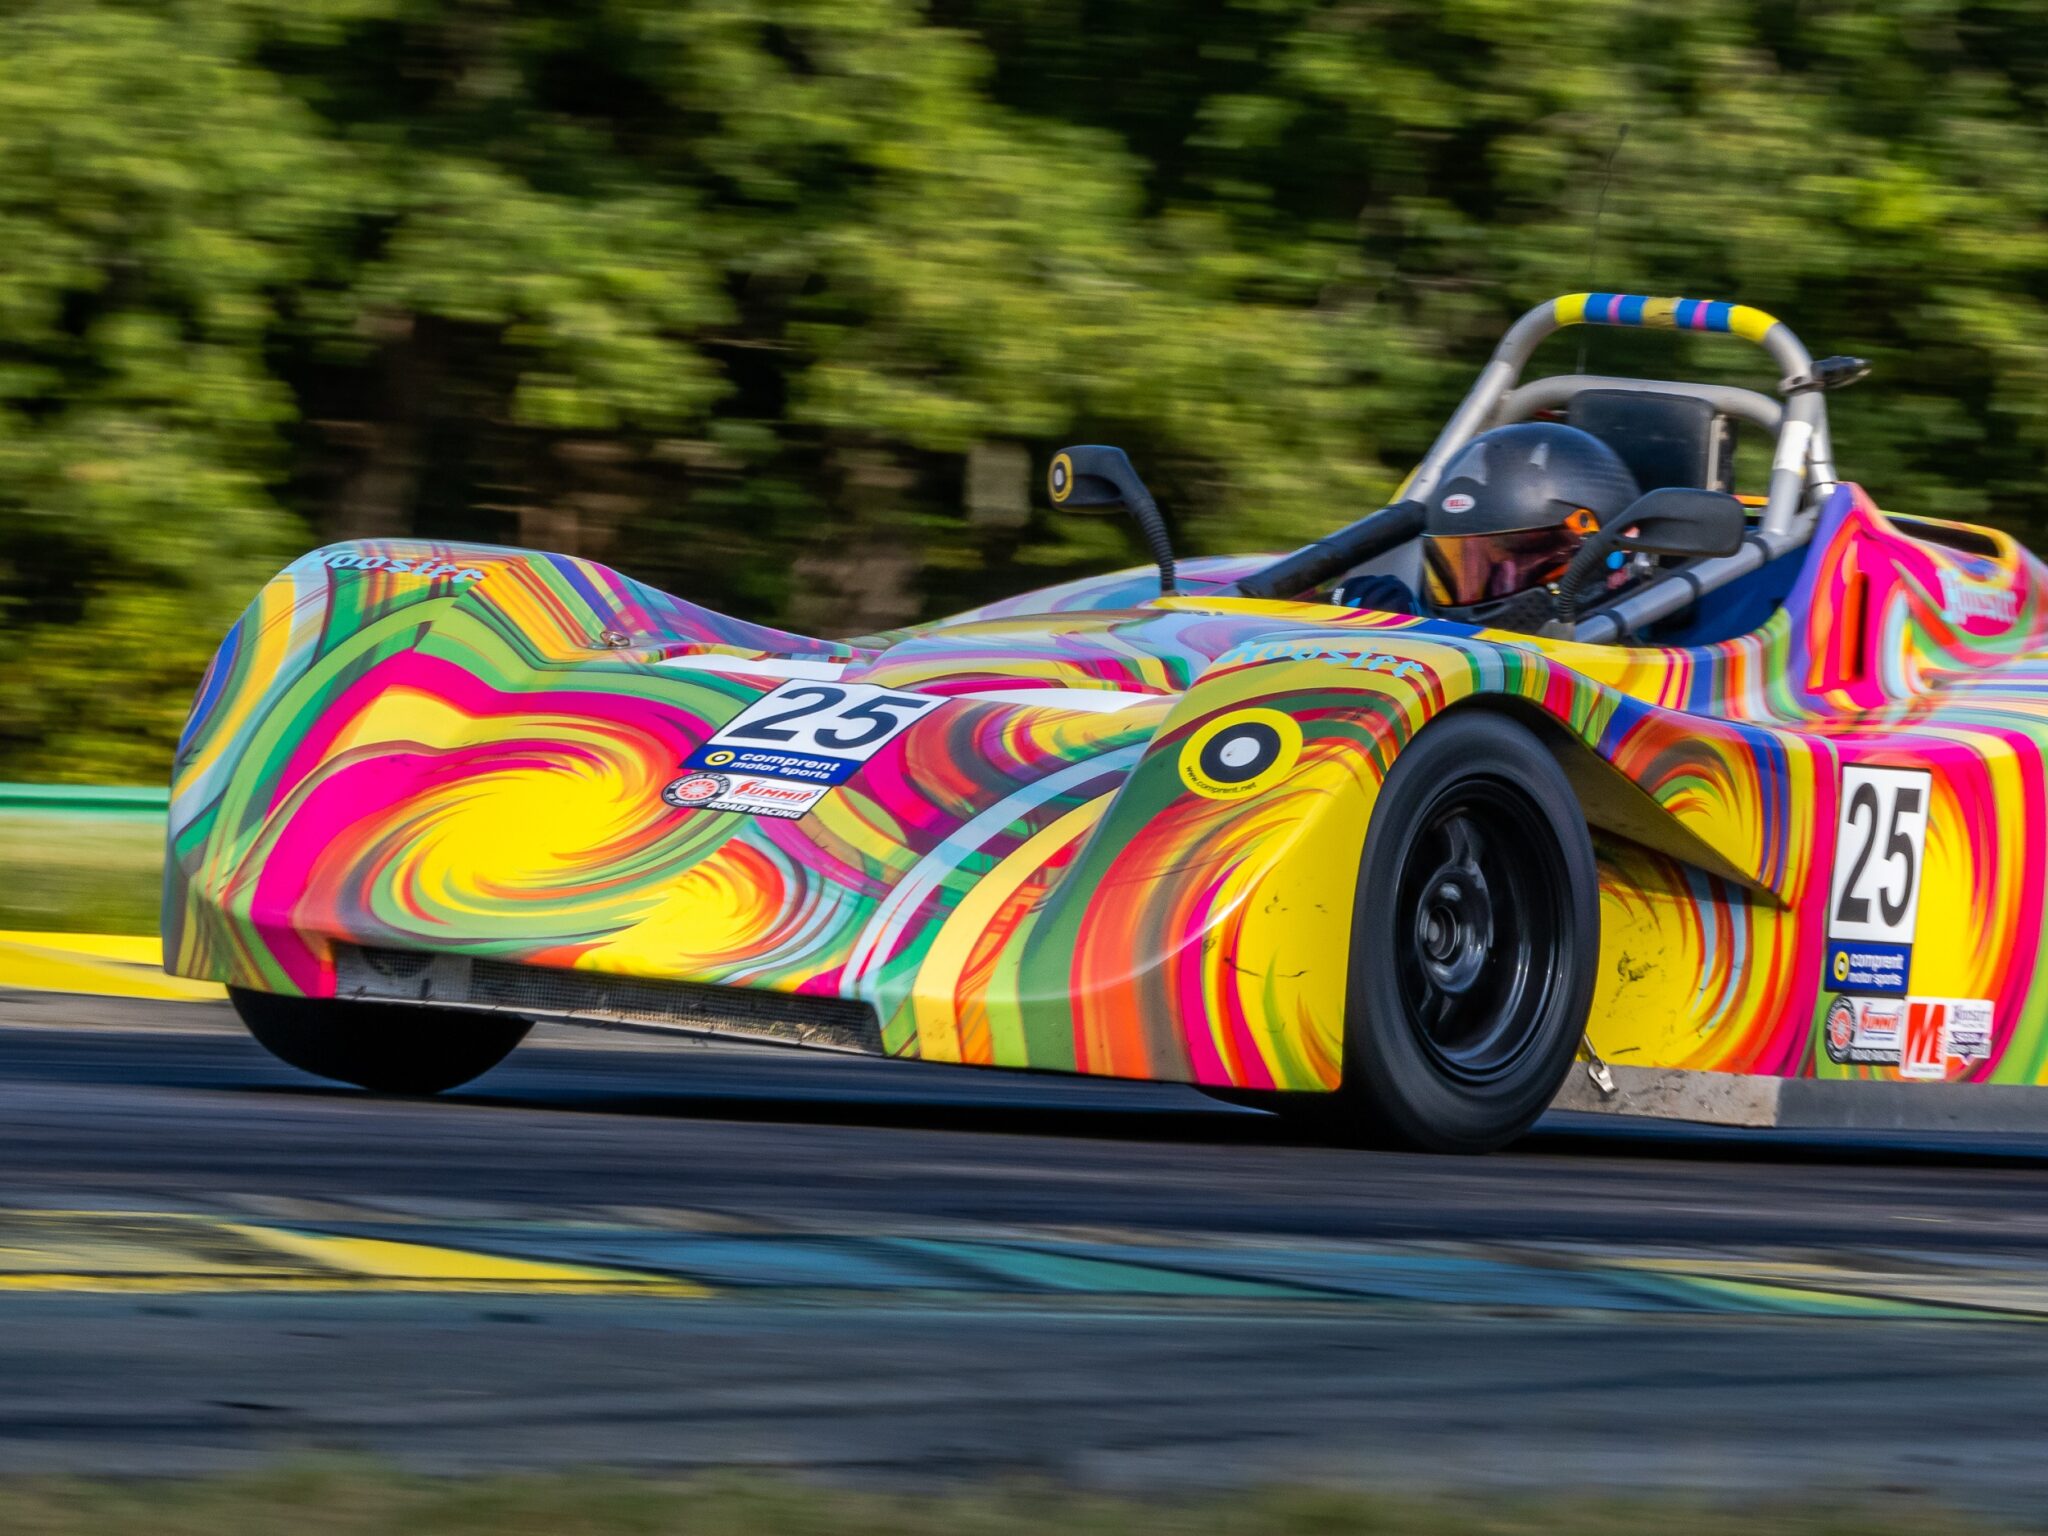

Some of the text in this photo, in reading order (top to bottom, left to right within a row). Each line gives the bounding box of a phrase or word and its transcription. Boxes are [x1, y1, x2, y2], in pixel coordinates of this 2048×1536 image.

[725, 686, 931, 750] 25
[729, 762, 831, 780] motor sports
[740, 753, 841, 772] comprent
[1186, 766, 1257, 793] www.comprent.net
[707, 802, 801, 818] ROAD RACING
[1836, 782, 1921, 927] 25
